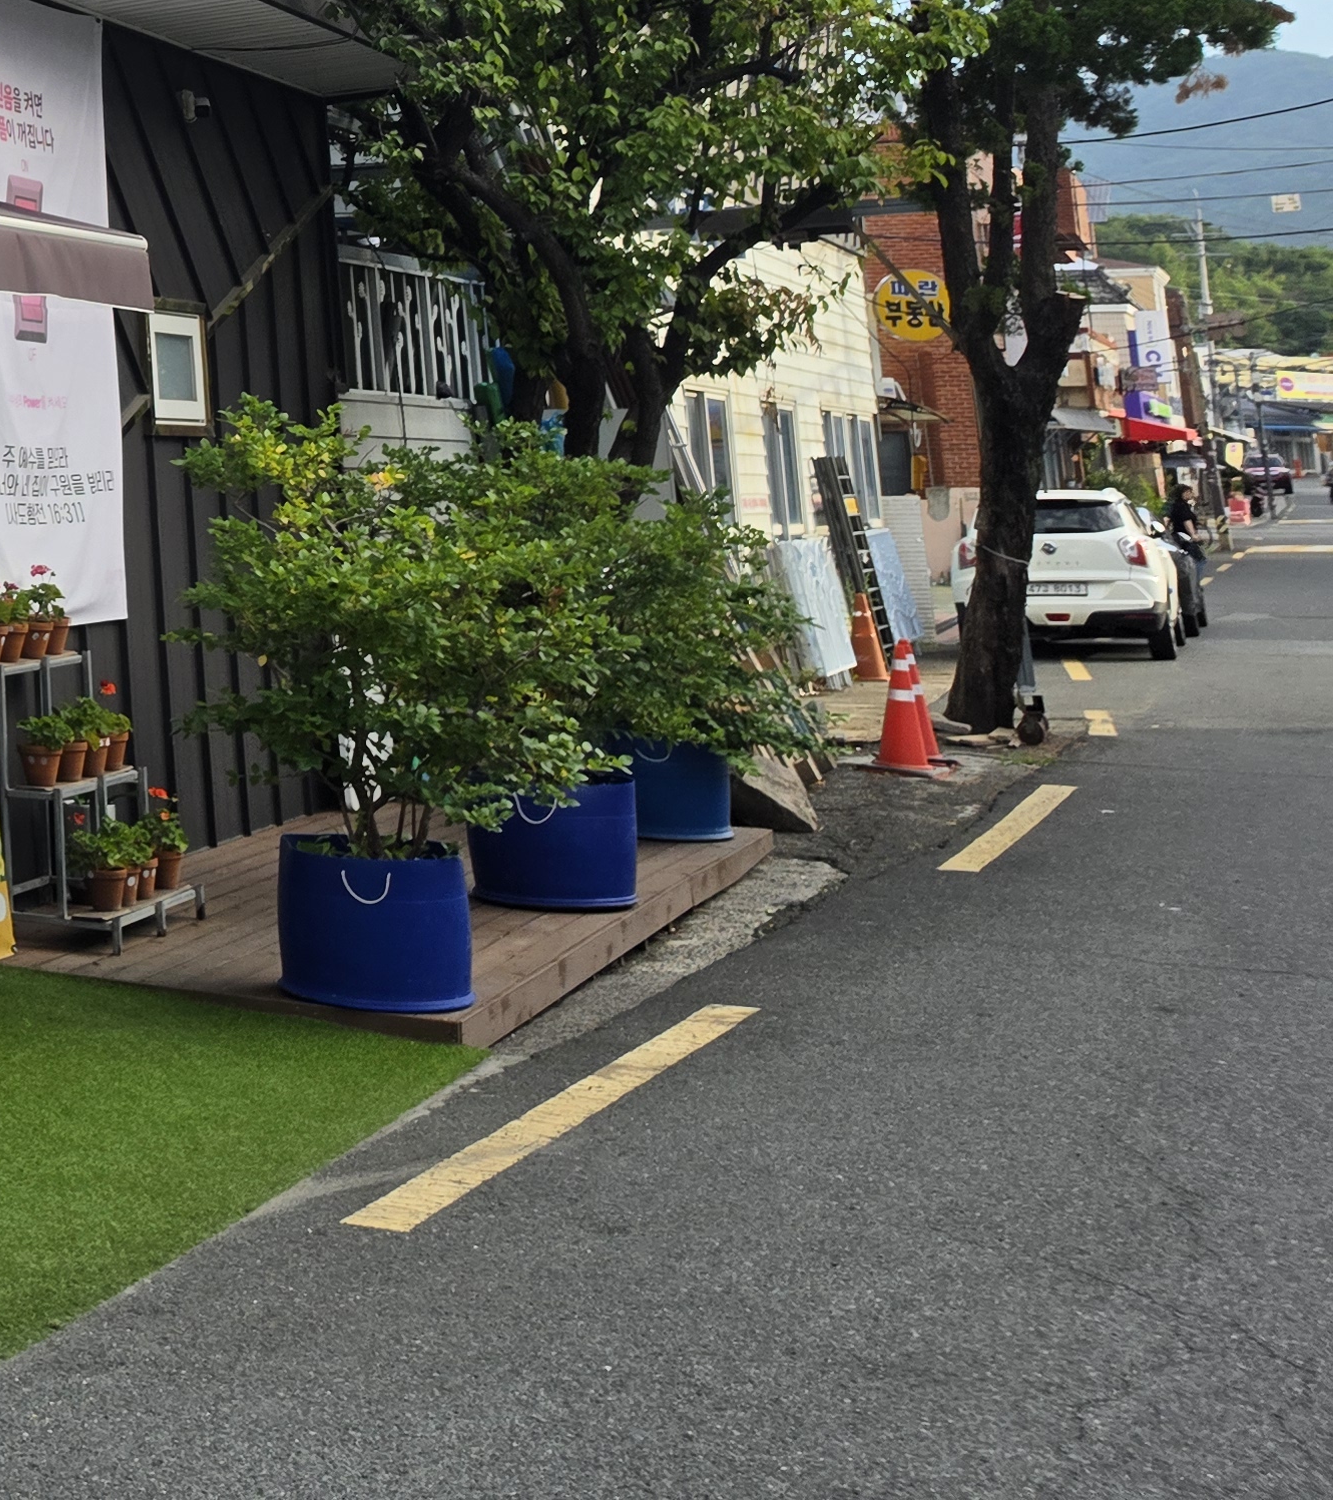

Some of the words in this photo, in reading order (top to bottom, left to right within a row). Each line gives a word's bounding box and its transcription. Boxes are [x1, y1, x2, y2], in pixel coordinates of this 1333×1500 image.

[884, 300, 945, 329] 부동산
[2, 445, 15, 469] 주
[49, 472, 86, 496] 구원을
